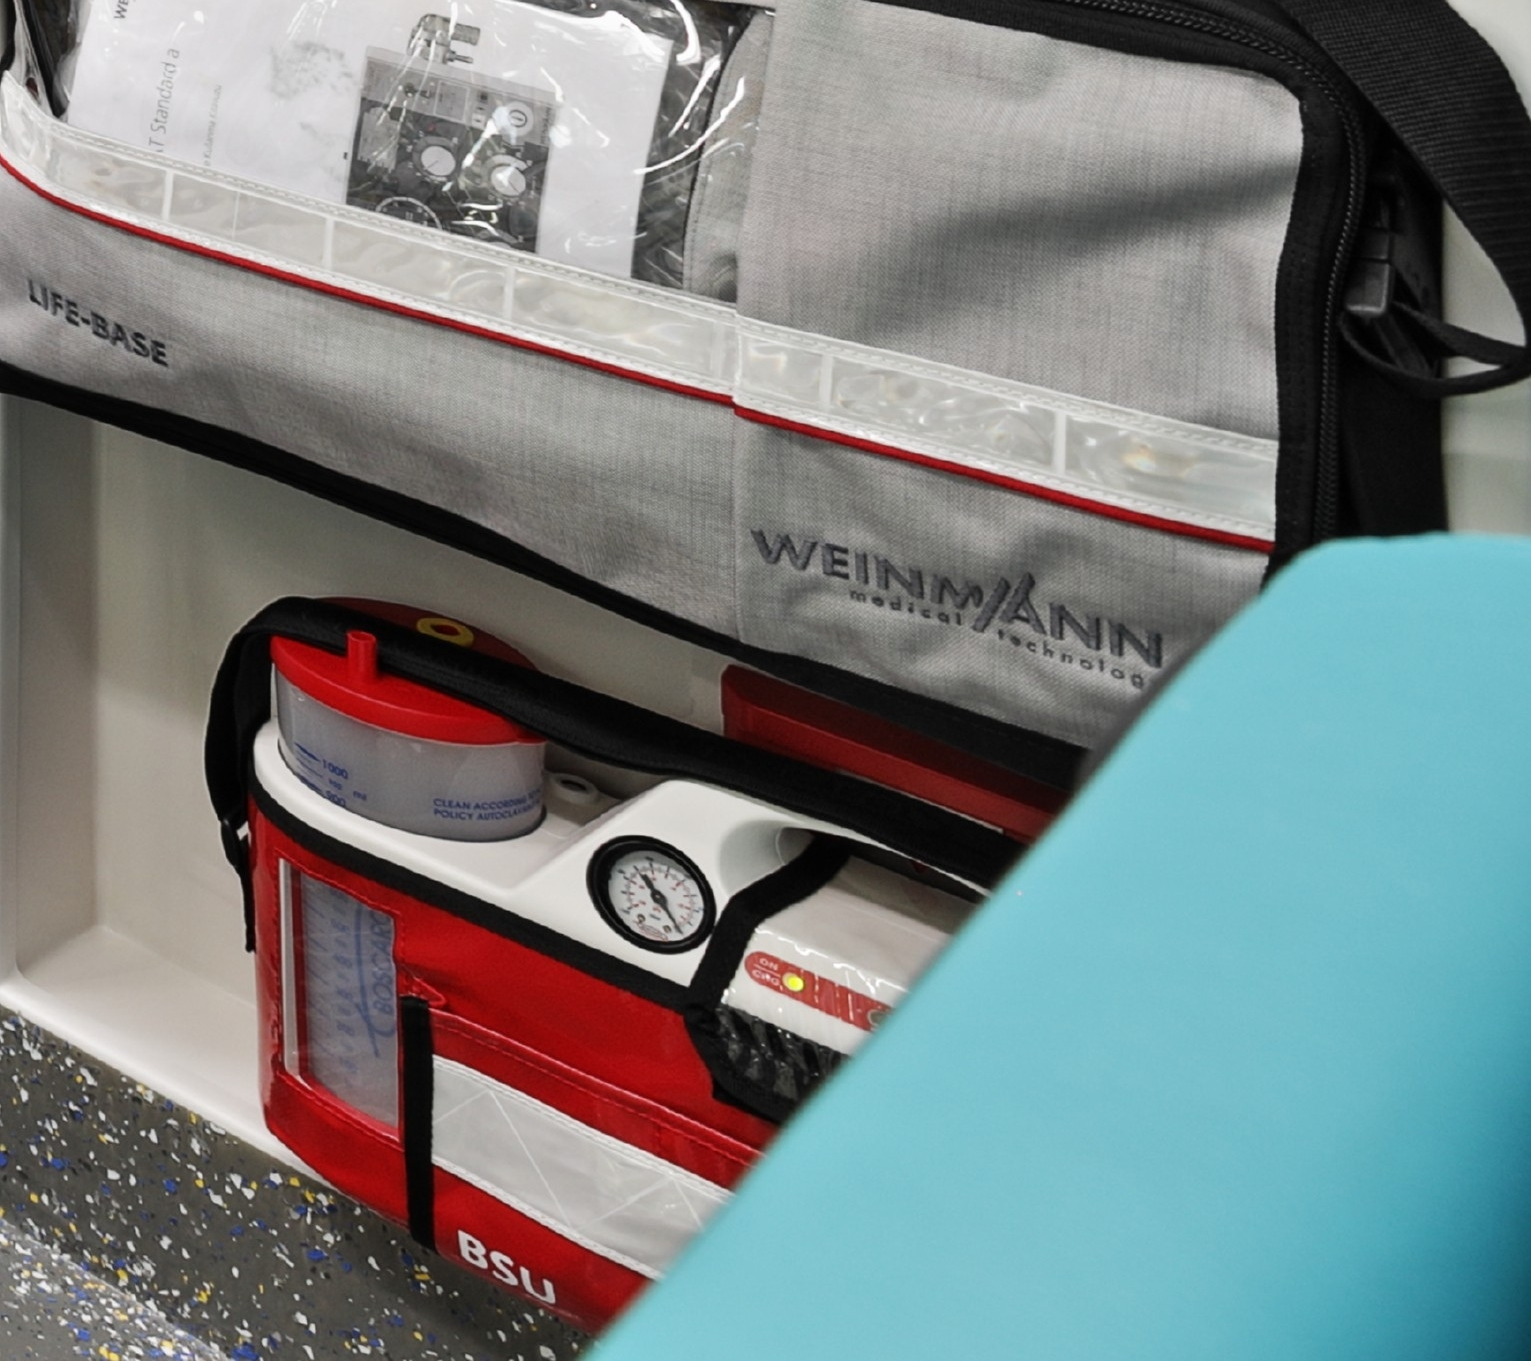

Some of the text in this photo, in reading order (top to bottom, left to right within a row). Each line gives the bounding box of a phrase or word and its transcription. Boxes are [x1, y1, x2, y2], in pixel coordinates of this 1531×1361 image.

[150, 61, 177, 135] Standard
[27, 278, 169, 368] LIFE-BASE
[750, 528, 1164, 669] WEINMANN
[849, 589, 963, 628] medical
[322, 759, 349, 780] 1000
[433, 798, 471, 810] CLEAN
[433, 808, 473, 820] POLICY
[457, 1229, 556, 1305] BSU
